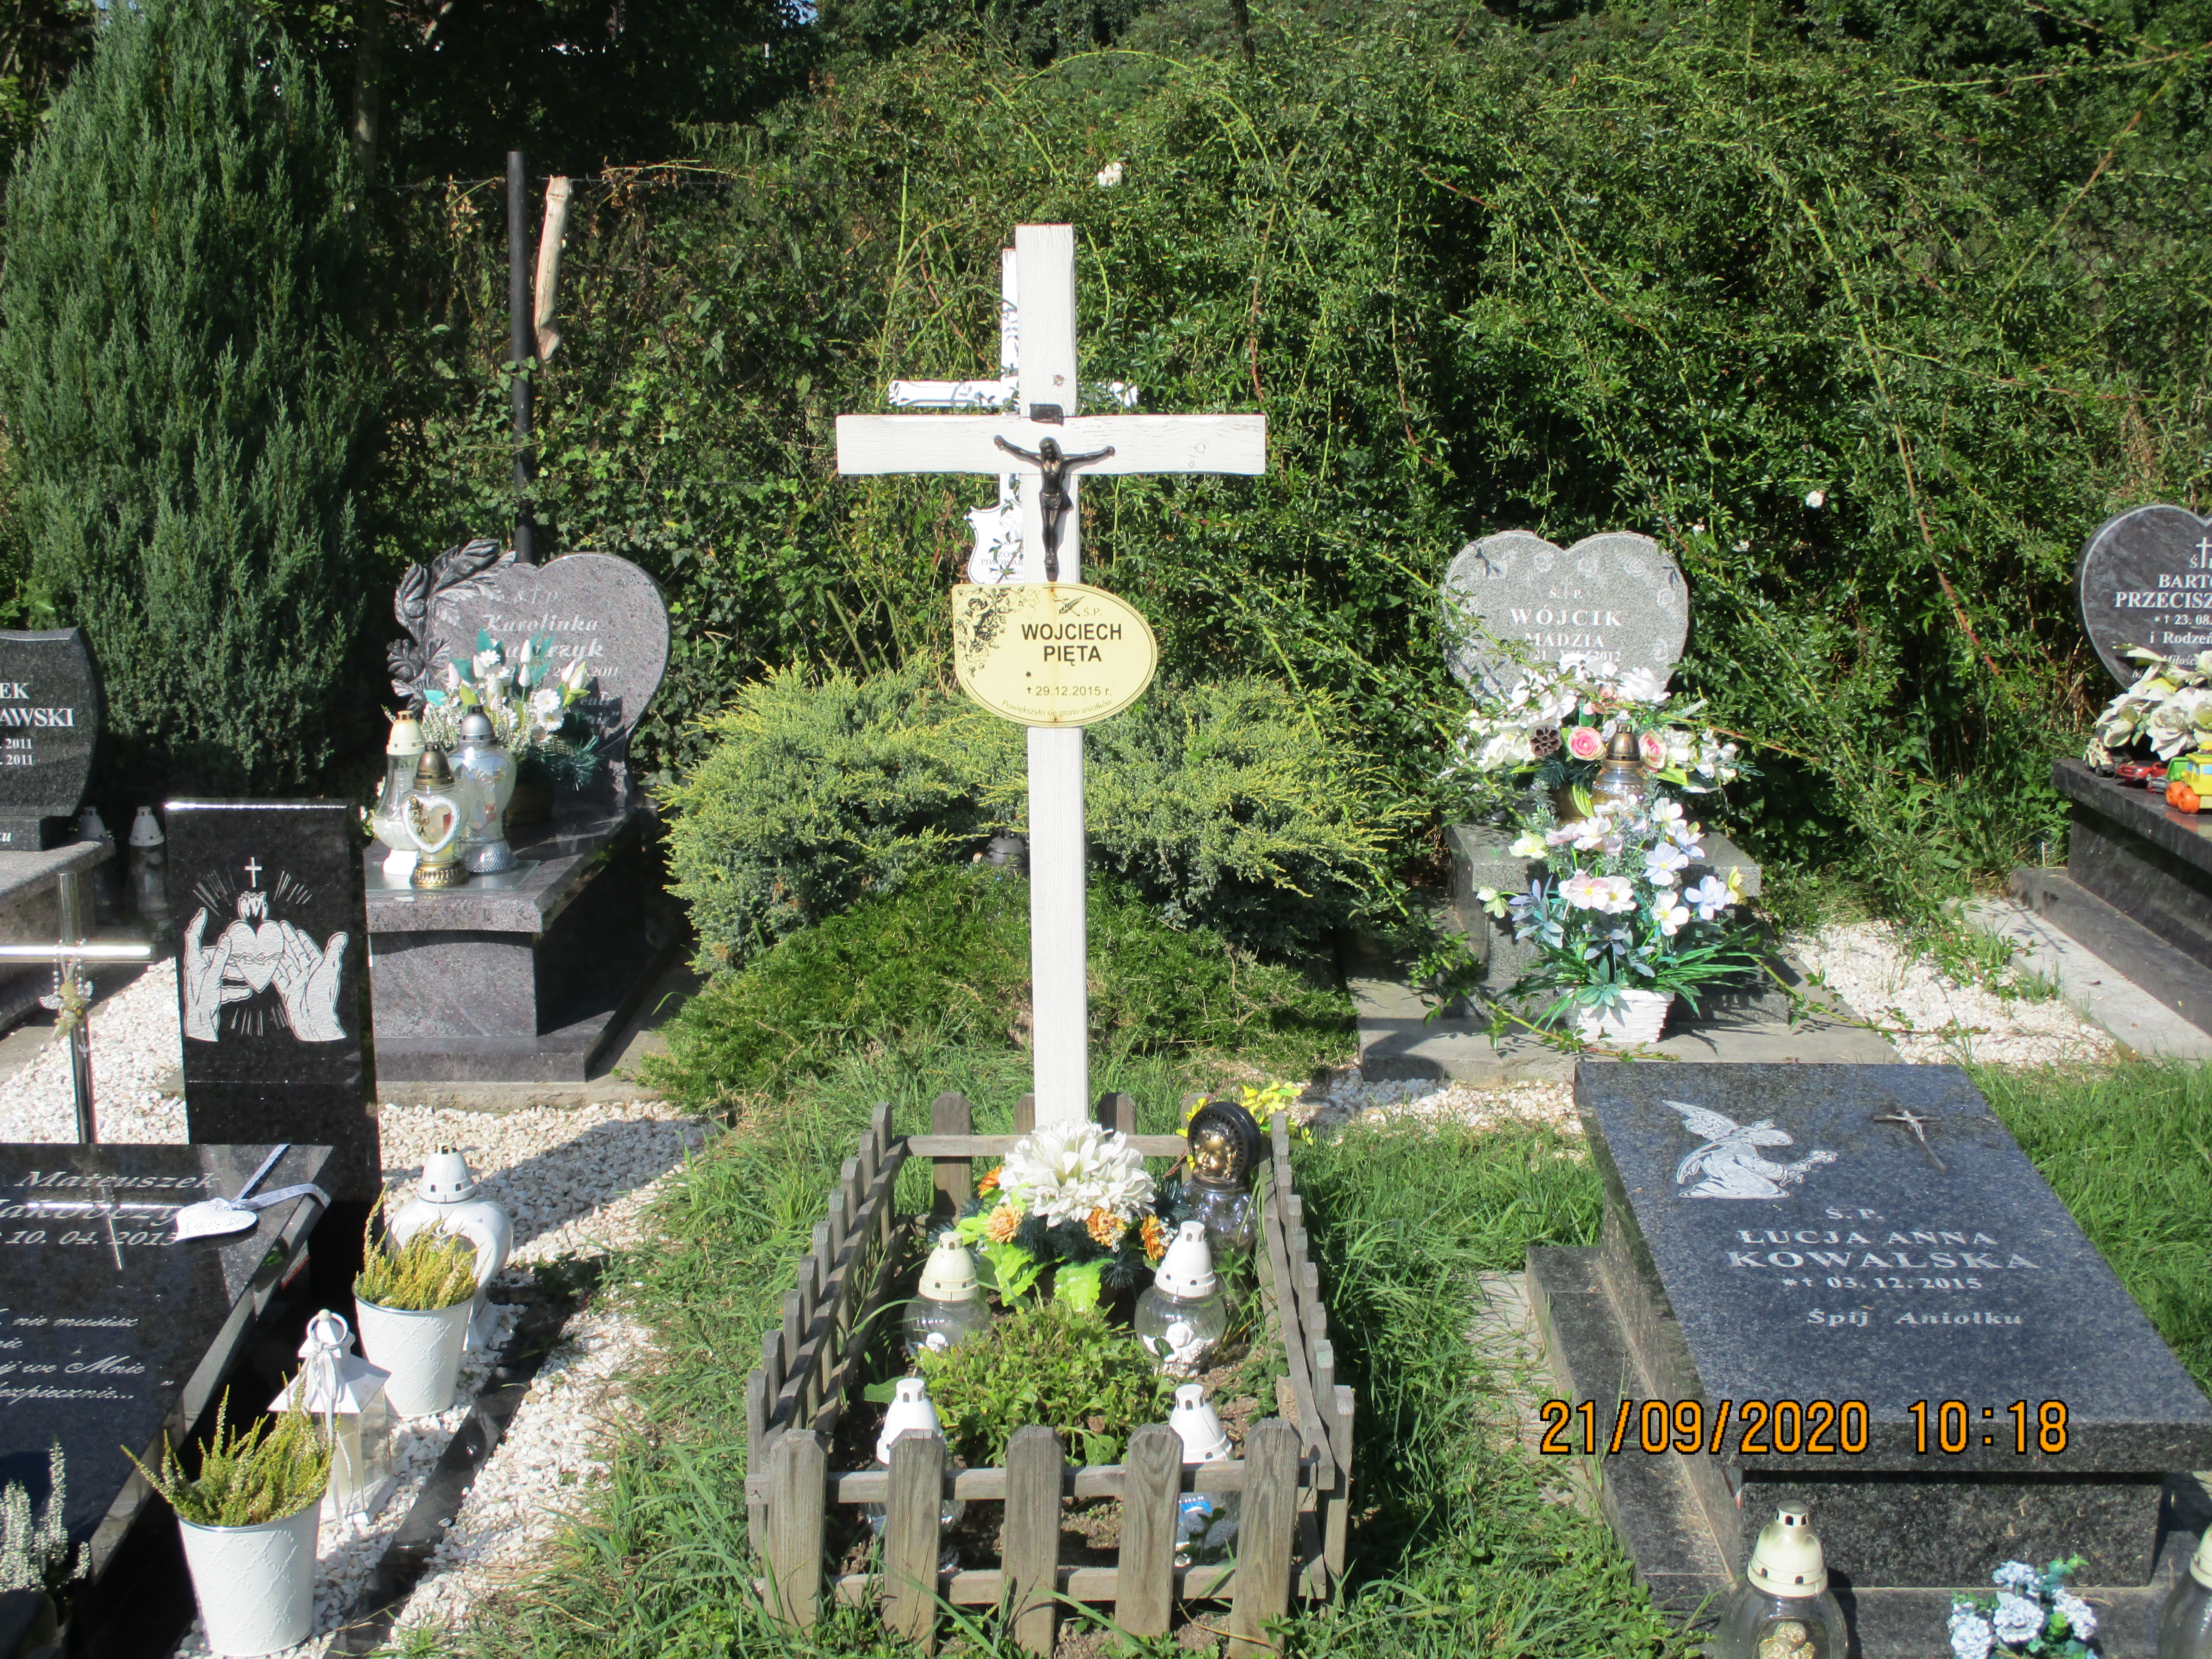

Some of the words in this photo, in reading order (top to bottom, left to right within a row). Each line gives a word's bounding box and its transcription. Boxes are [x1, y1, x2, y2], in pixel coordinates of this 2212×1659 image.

[2158, 574, 2212, 589] BART
[482, 614, 599, 631] Karolinka
[1509, 604, 1623, 626] WÓJCIK
[1021, 623, 1122, 640] WOJCIECH
[1525, 632, 1604, 647] MADZIA
[1043, 645, 1102, 666] PIĘTA
[1035, 686, 1101, 696] 29.12.2015
[1105, 687, 1112, 696] r.
[1002, 699, 1045, 717] Powiększyło
[1059, 709, 1079, 718] grono
[1081, 699, 1112, 714] aniołków
[5, 738, 33, 749] 2011
[6, 754, 34, 766] 2011
[14, 1171, 220, 1188] Mateuszek
[1887, 1231, 1998, 1245] ANNA
[1726, 1251, 2042, 1269] KOWALSKA
